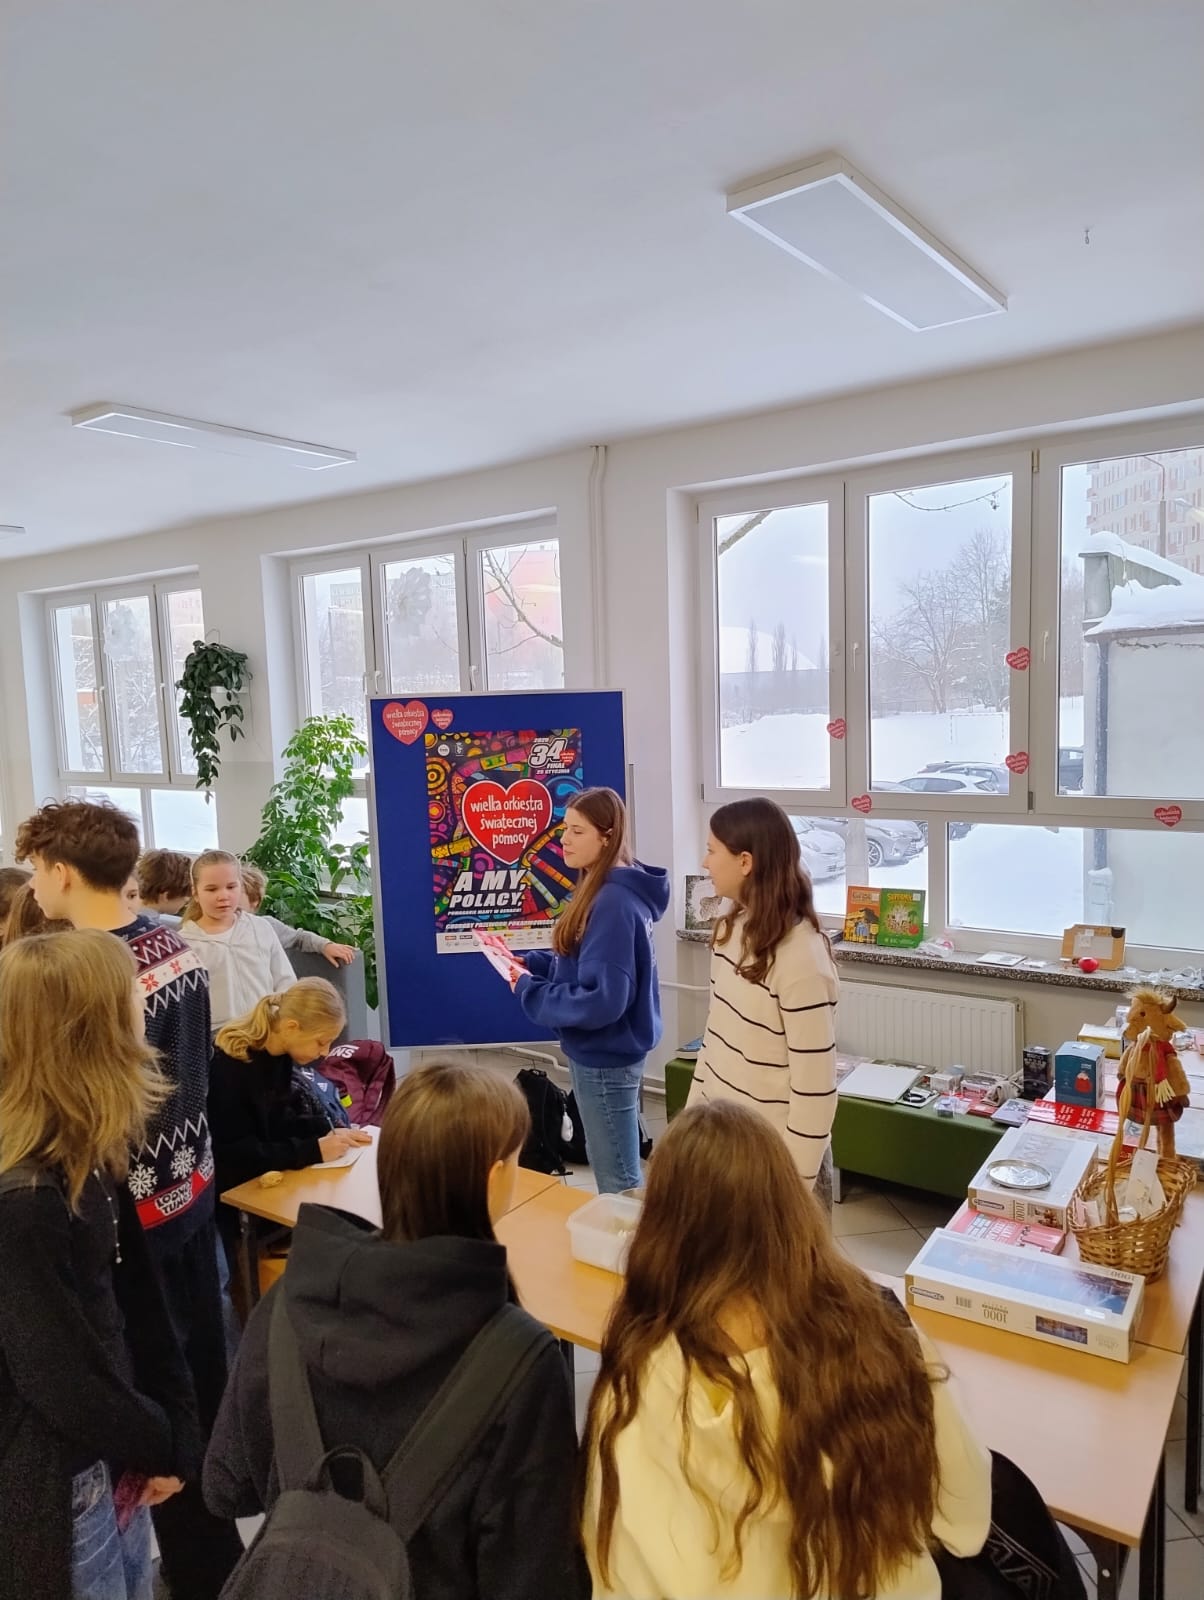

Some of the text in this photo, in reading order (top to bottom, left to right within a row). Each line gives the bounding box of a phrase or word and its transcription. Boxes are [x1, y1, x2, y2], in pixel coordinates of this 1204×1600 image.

[528, 738, 567, 768] 34
[470, 795, 543, 812] wielka orkiestra
[480, 813, 537, 835] świątecznej
[492, 833, 529, 849] pomocy
[453, 869, 527, 892] A MY,
[449, 892, 522, 909] POLACY,
[983, 1308, 1007, 1324] 1000
